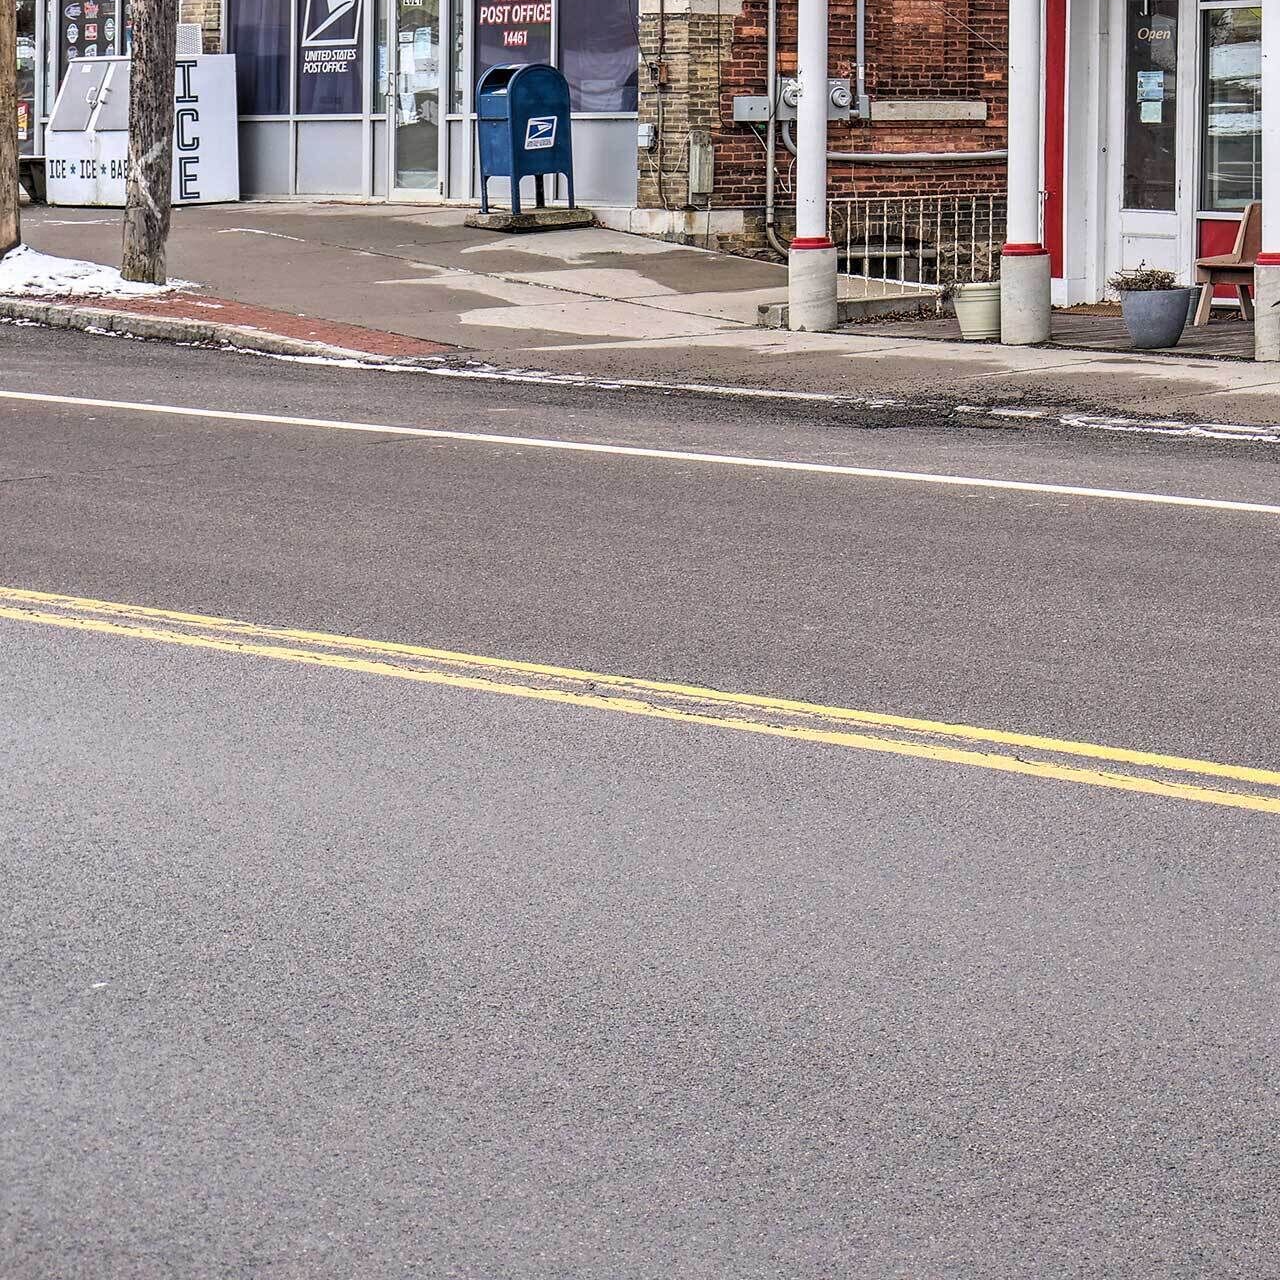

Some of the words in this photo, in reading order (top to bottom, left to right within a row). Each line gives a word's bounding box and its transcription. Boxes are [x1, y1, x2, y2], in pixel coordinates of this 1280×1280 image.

[480, 6, 511, 25] POST
[511, 3, 551, 22] OFFICE
[503, 30, 528, 46] 14461
[1137, 27, 1171, 41] Open
[305, 50, 332, 62] UNITED
[331, 49, 356, 60] STATES
[303, 62, 322, 74] POST
[176, 60, 200, 200] ICE
[49, 159, 67, 179] ICE
[80, 159, 97, 179] ICE
